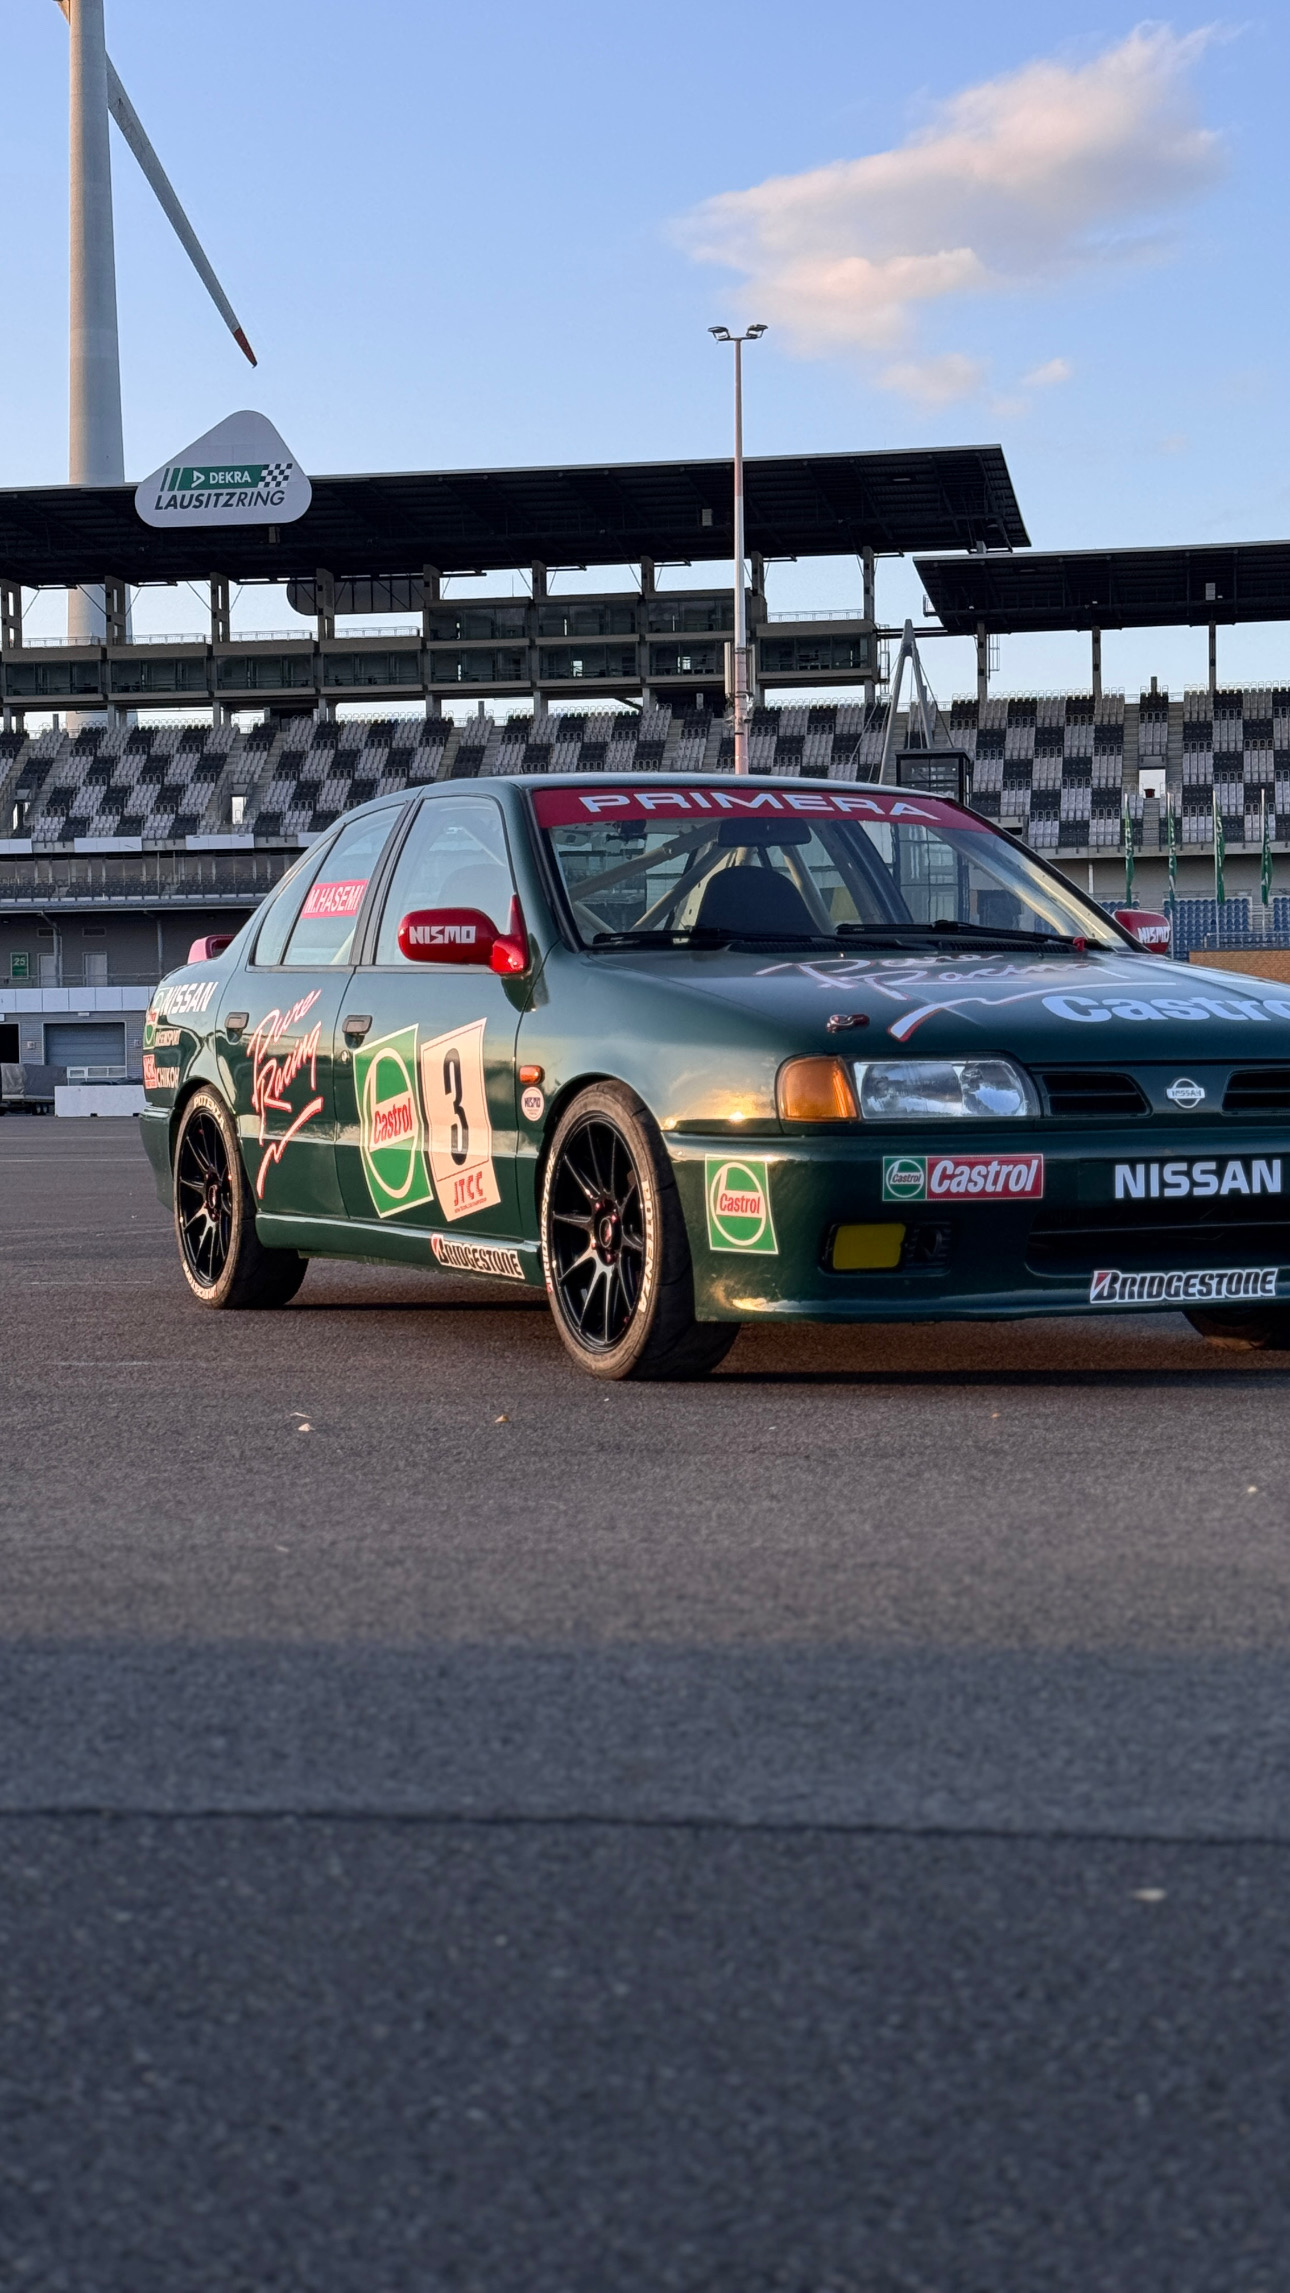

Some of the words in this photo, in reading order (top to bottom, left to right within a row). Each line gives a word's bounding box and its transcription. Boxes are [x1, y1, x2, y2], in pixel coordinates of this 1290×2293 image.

[209, 470, 252, 485] DEKRA
[154, 490, 285, 511] LAUSITZRING
[578, 792, 941, 821] PRIMERA
[304, 884, 365, 914] M.HASEMI
[409, 925, 477, 945] NISMO
[1137, 926, 1170, 944] NISMO
[13, 957, 26, 966] 25
[160, 981, 220, 1016] NISSAN
[252, 1020, 322, 1146] Racing
[193, 1095, 225, 1131] POTENZA
[373, 1097, 413, 1145] Castrol
[443, 1047, 470, 1166] 3
[453, 1170, 484, 1207] JTCC
[892, 1171, 921, 1184] Castrol
[930, 1159, 1039, 1194] Castrol
[1114, 1159, 1282, 1199] NISSAN
[719, 1192, 761, 1215] Castrol
[431, 1235, 524, 1278] BRIDGESTONE
[638, 1180, 654, 1313] POTENZA
[1090, 1268, 1278, 1303] BRIDGESTONE
